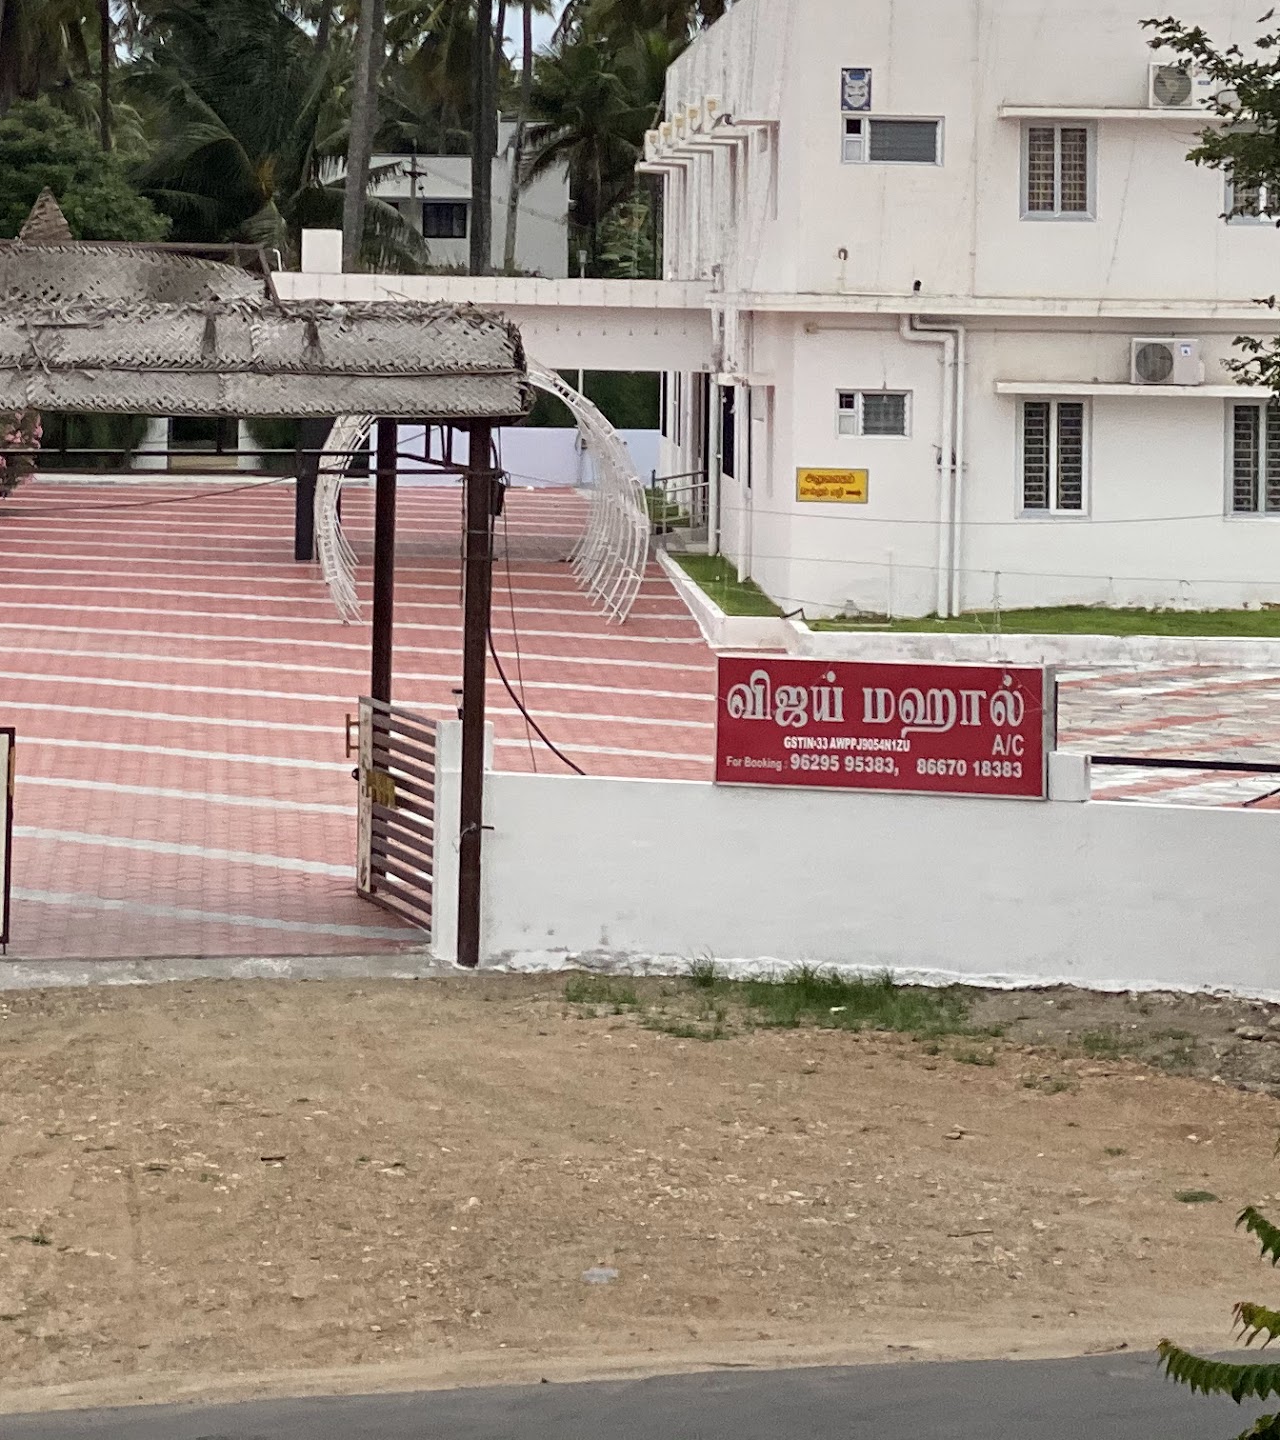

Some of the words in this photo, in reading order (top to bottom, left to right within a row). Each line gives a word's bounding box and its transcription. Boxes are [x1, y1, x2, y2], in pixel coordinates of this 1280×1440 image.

[727, 669, 845, 728] விஜய்
[862, 674, 1024, 738] மஹால்
[992, 734, 1024, 756] A/C
[726, 755, 742, 767] For
[790, 753, 840, 772] 96295
[844, 755, 899, 776] 95383,
[916, 758, 967, 777] 86670
[972, 760, 1023, 778] 18383
